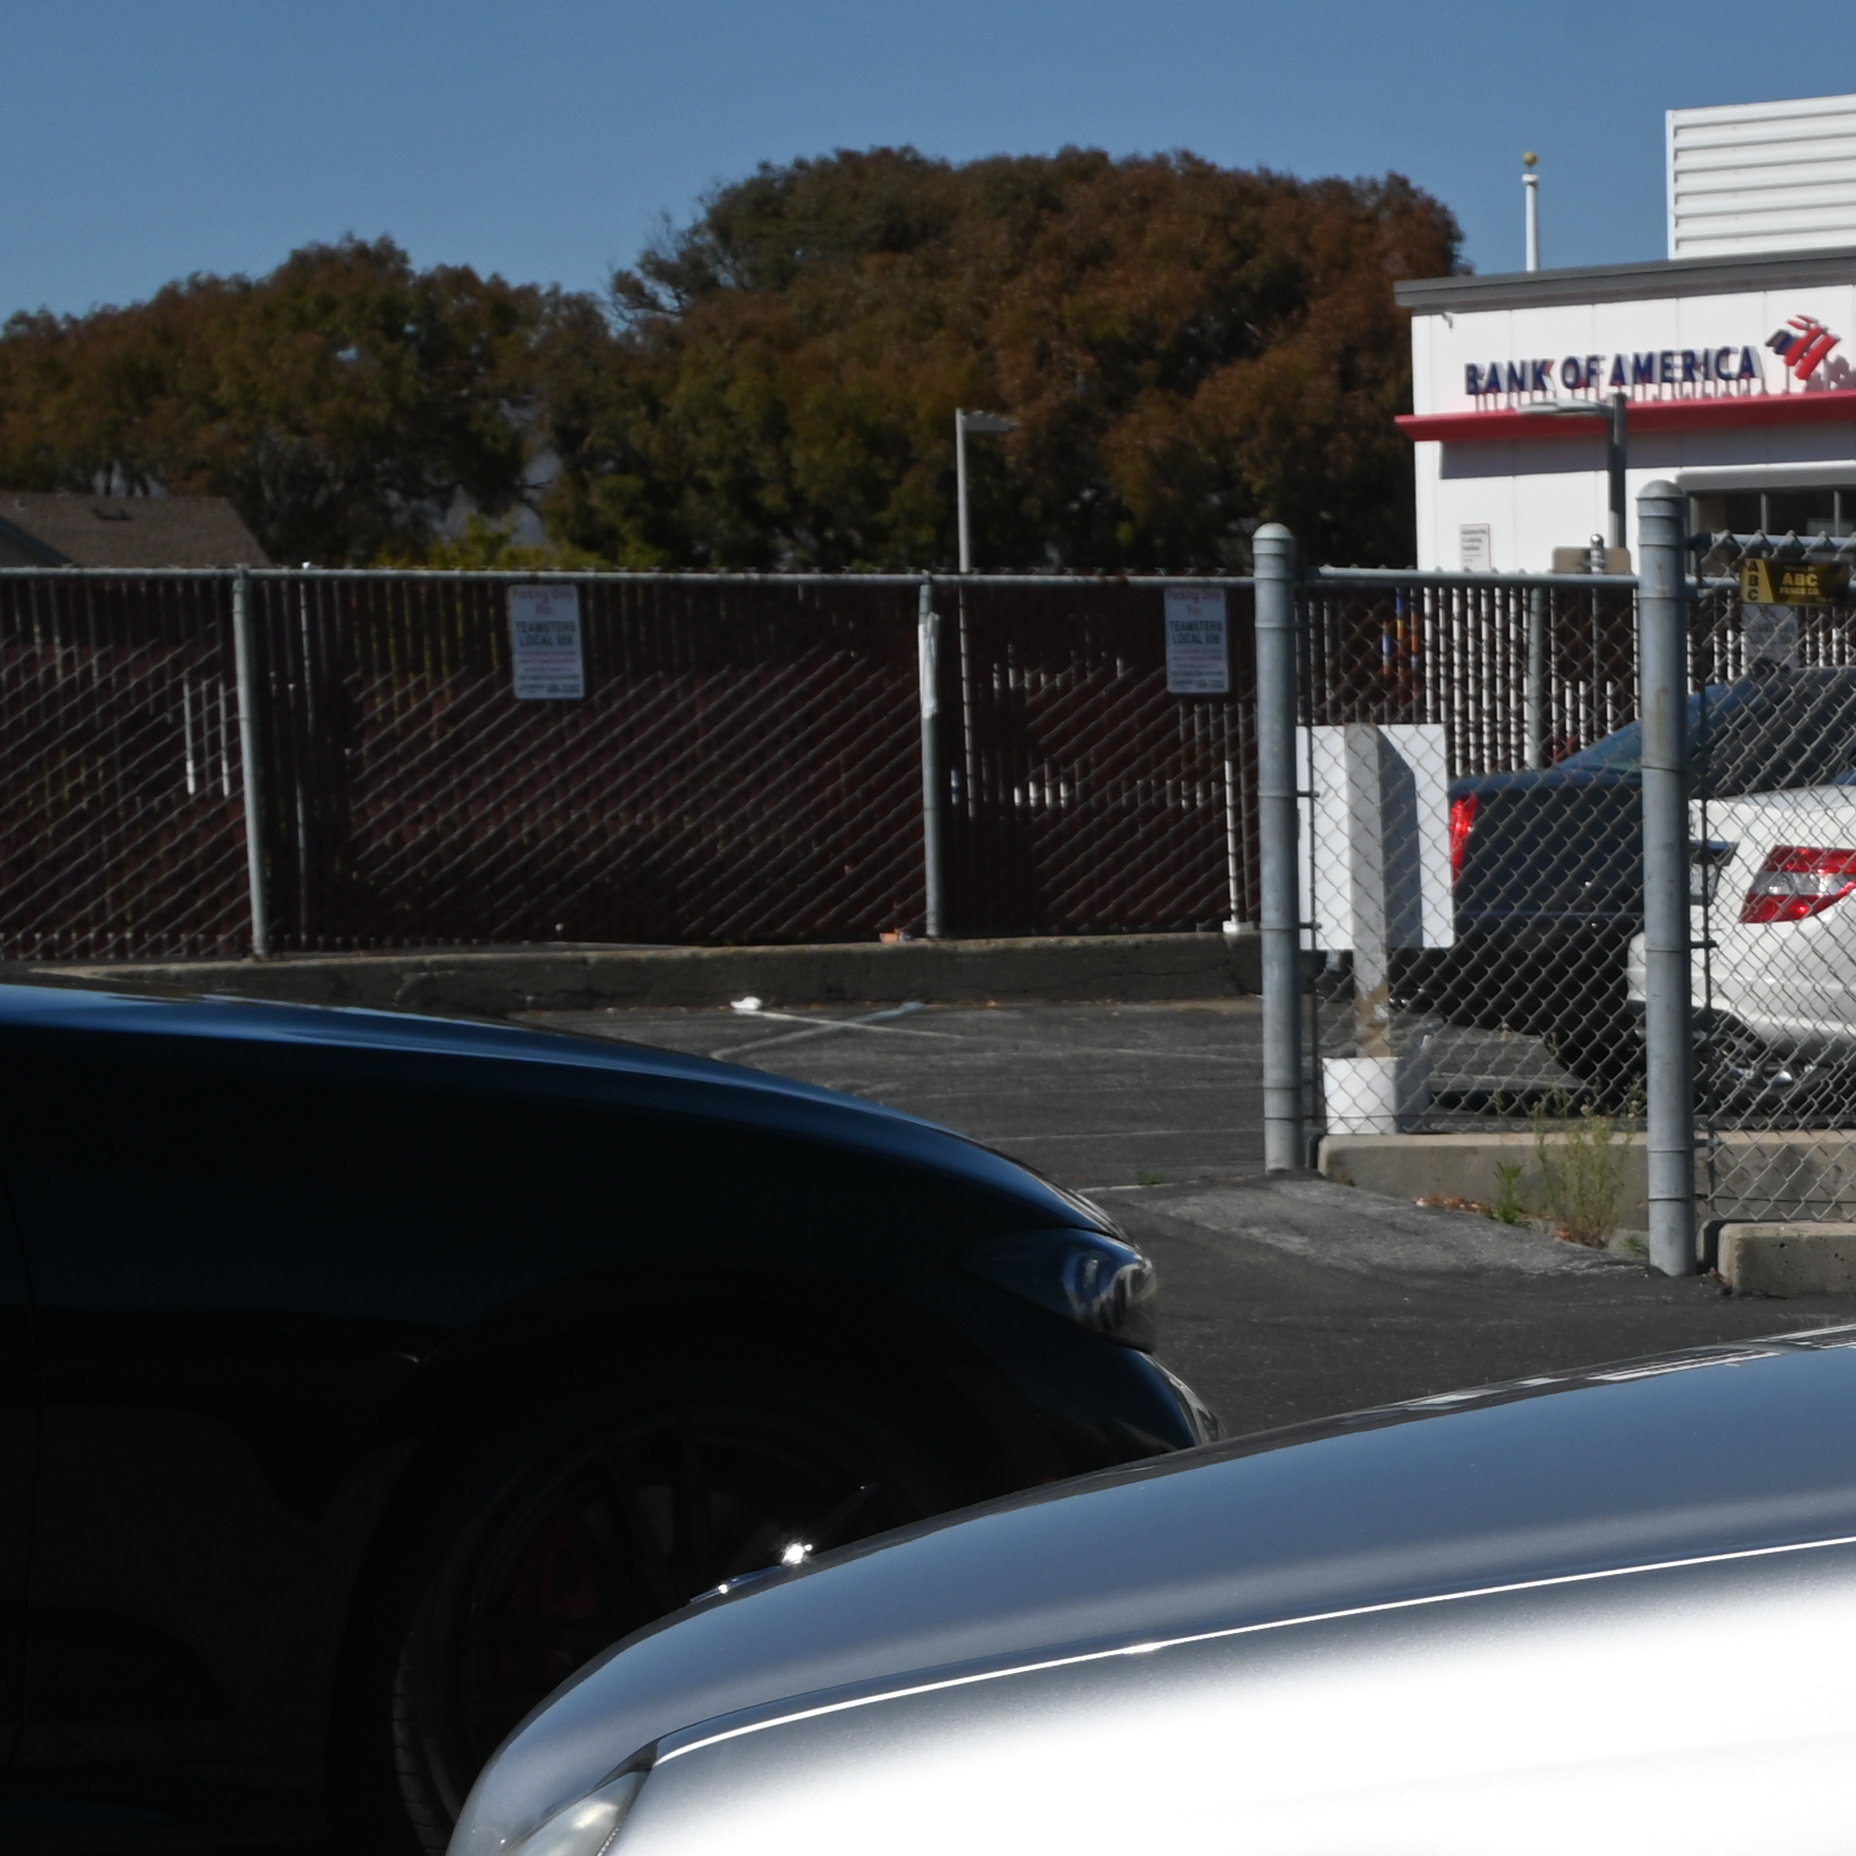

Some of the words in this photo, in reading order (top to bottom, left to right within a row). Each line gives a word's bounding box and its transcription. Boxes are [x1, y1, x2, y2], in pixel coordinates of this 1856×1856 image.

[1463, 360, 1552, 396] BANK
[1560, 354, 1604, 389] OF
[1608, 345, 1759, 387] AMERICA
[1782, 572, 1818, 587] ABC
